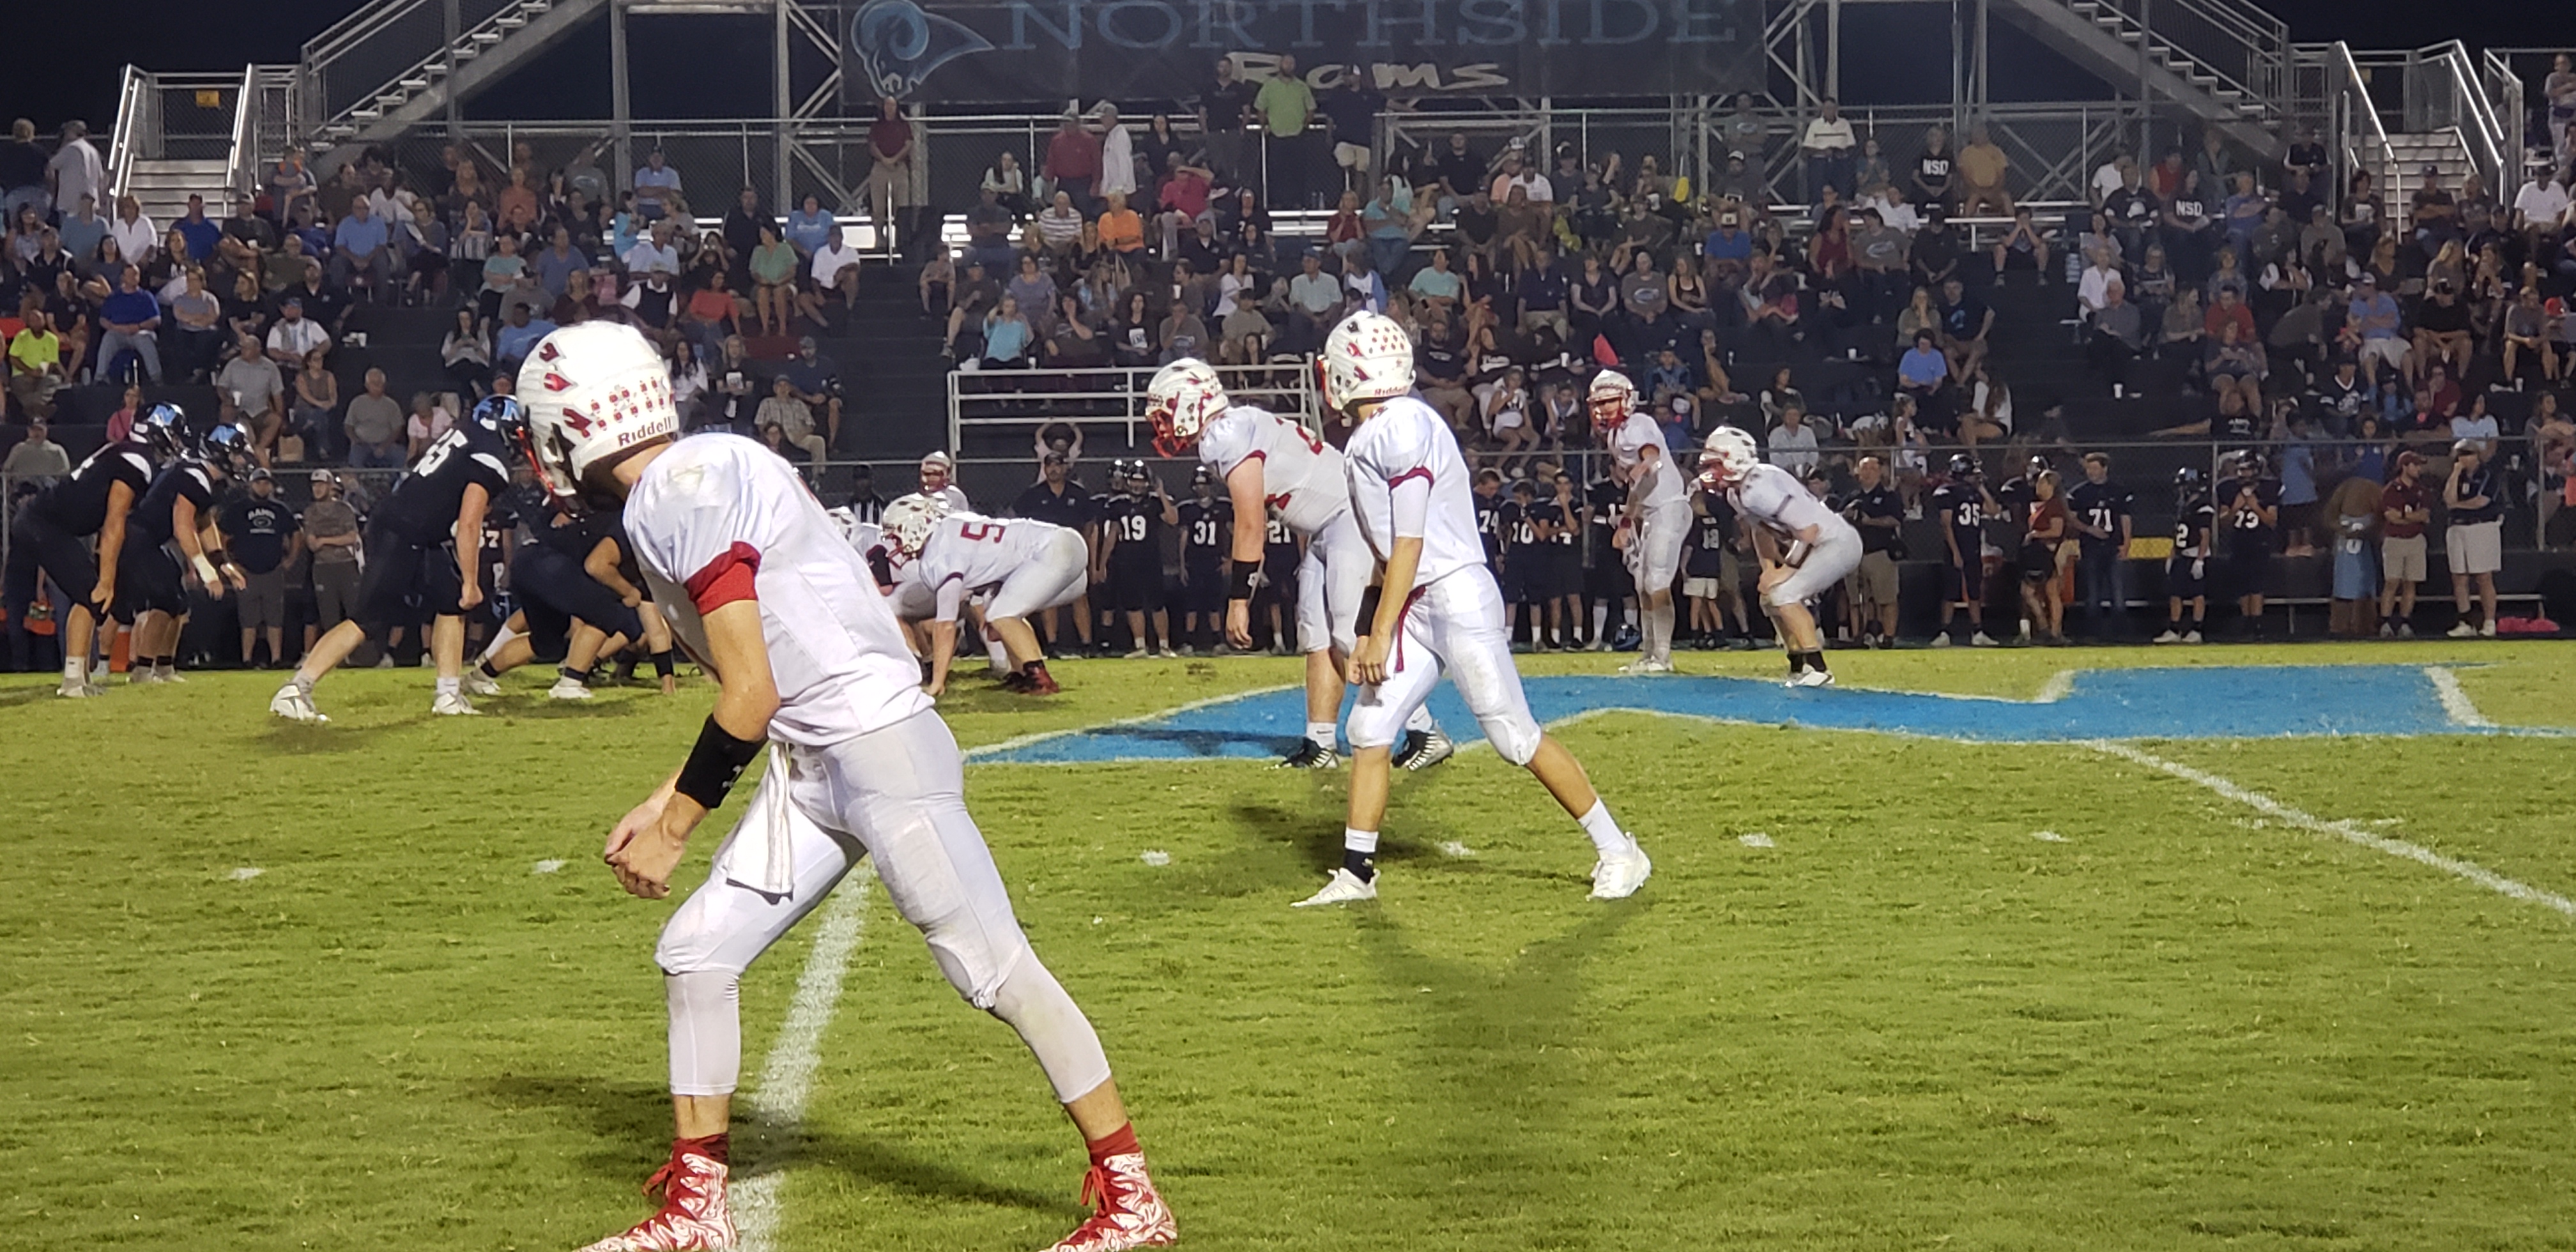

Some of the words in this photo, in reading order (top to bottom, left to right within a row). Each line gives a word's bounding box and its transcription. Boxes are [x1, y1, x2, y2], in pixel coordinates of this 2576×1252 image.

[995, 0, 1736, 50] NORTHSIDE
[1220, 51, 1509, 90] Rams
[2175, 200, 2203, 217] NSD
[617, 416, 671, 447] Riddell
[1958, 503, 1980, 526] 35
[2089, 509, 2113, 531] 71
[1121, 515, 1146, 540] 19
[1193, 521, 1216, 545] 31
[1268, 521, 1291, 543] 21
[1512, 521, 1533, 543] 10
